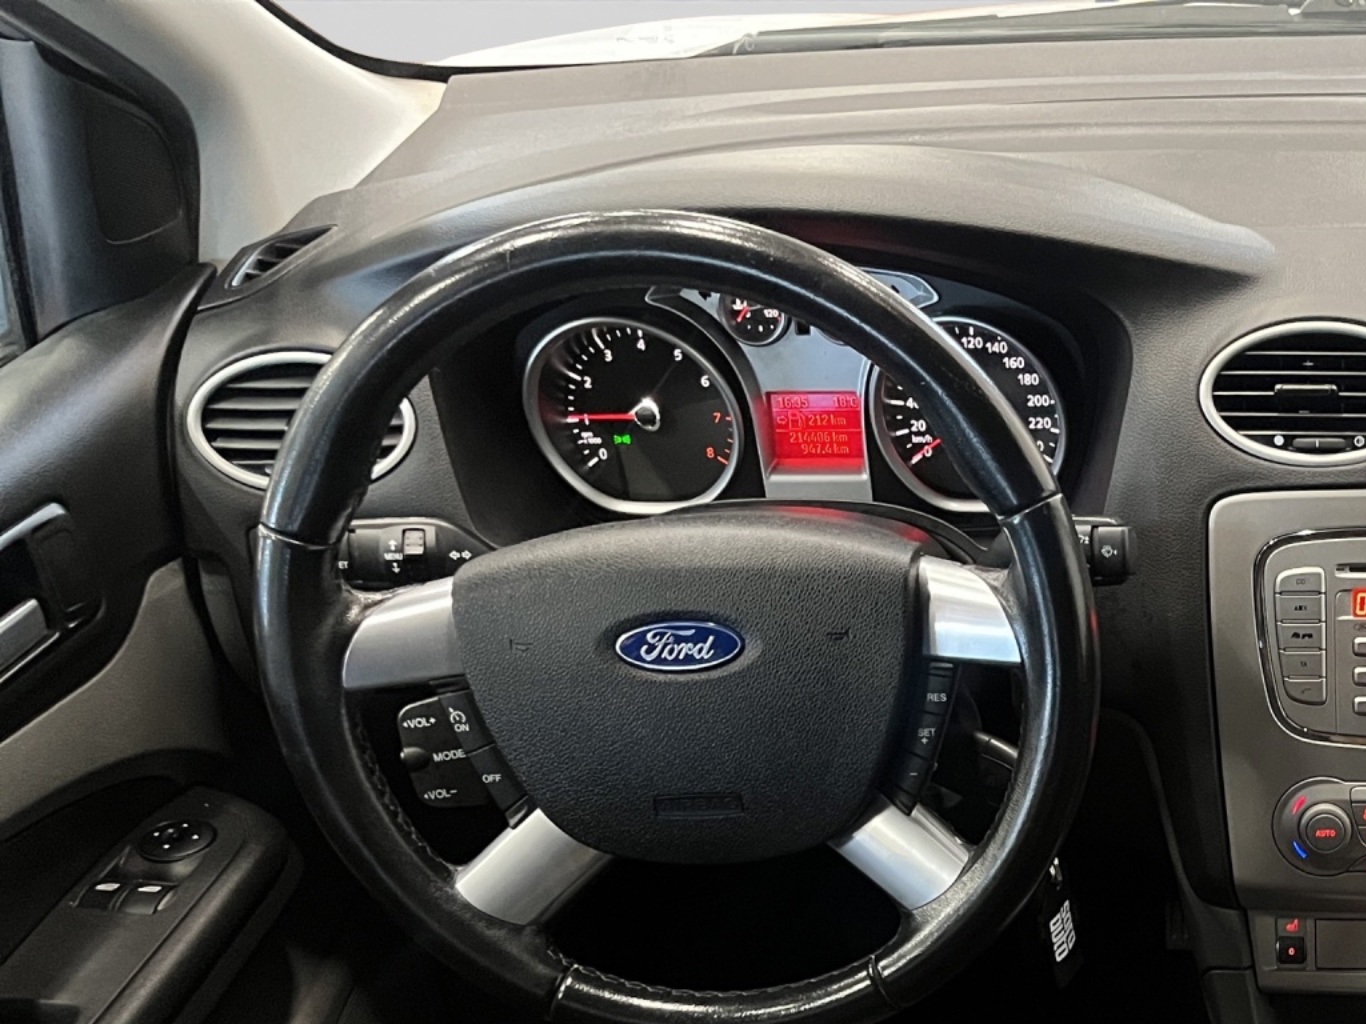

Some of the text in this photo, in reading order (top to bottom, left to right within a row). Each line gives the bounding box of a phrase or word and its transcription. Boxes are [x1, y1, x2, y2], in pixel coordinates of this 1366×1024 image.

[763, 308, 780, 318] 120
[637, 338, 646, 351] 4
[961, 337, 984, 349] 120
[985, 341, 1008, 354] 140
[604, 349, 613, 362] 3
[673, 349, 683, 361] 5
[1003, 357, 1025, 369] 160
[583, 376, 592, 389] 2
[700, 375, 710, 388] 6
[1017, 373, 1040, 386] 180
[1027, 394, 1050, 407] 200
[713, 412, 721, 423] 7
[808, 413, 847, 426] 212 km
[1028, 416, 1052, 429] 220
[910, 419, 927, 432] 20
[832, 431, 848, 443] km
[911, 433, 933, 444] km/h
[598, 447, 608, 460] 0
[706, 447, 715, 459] 8
[833, 443, 849, 455] km
[639, 628, 716, 661] Ford
[926, 692, 948, 702] RES
[453, 723, 470, 732] ON
[917, 727, 937, 737] SET
[432, 748, 467, 763] MODE
[482, 773, 502, 784] OFF
[1315, 829, 1337, 838] AUTO
